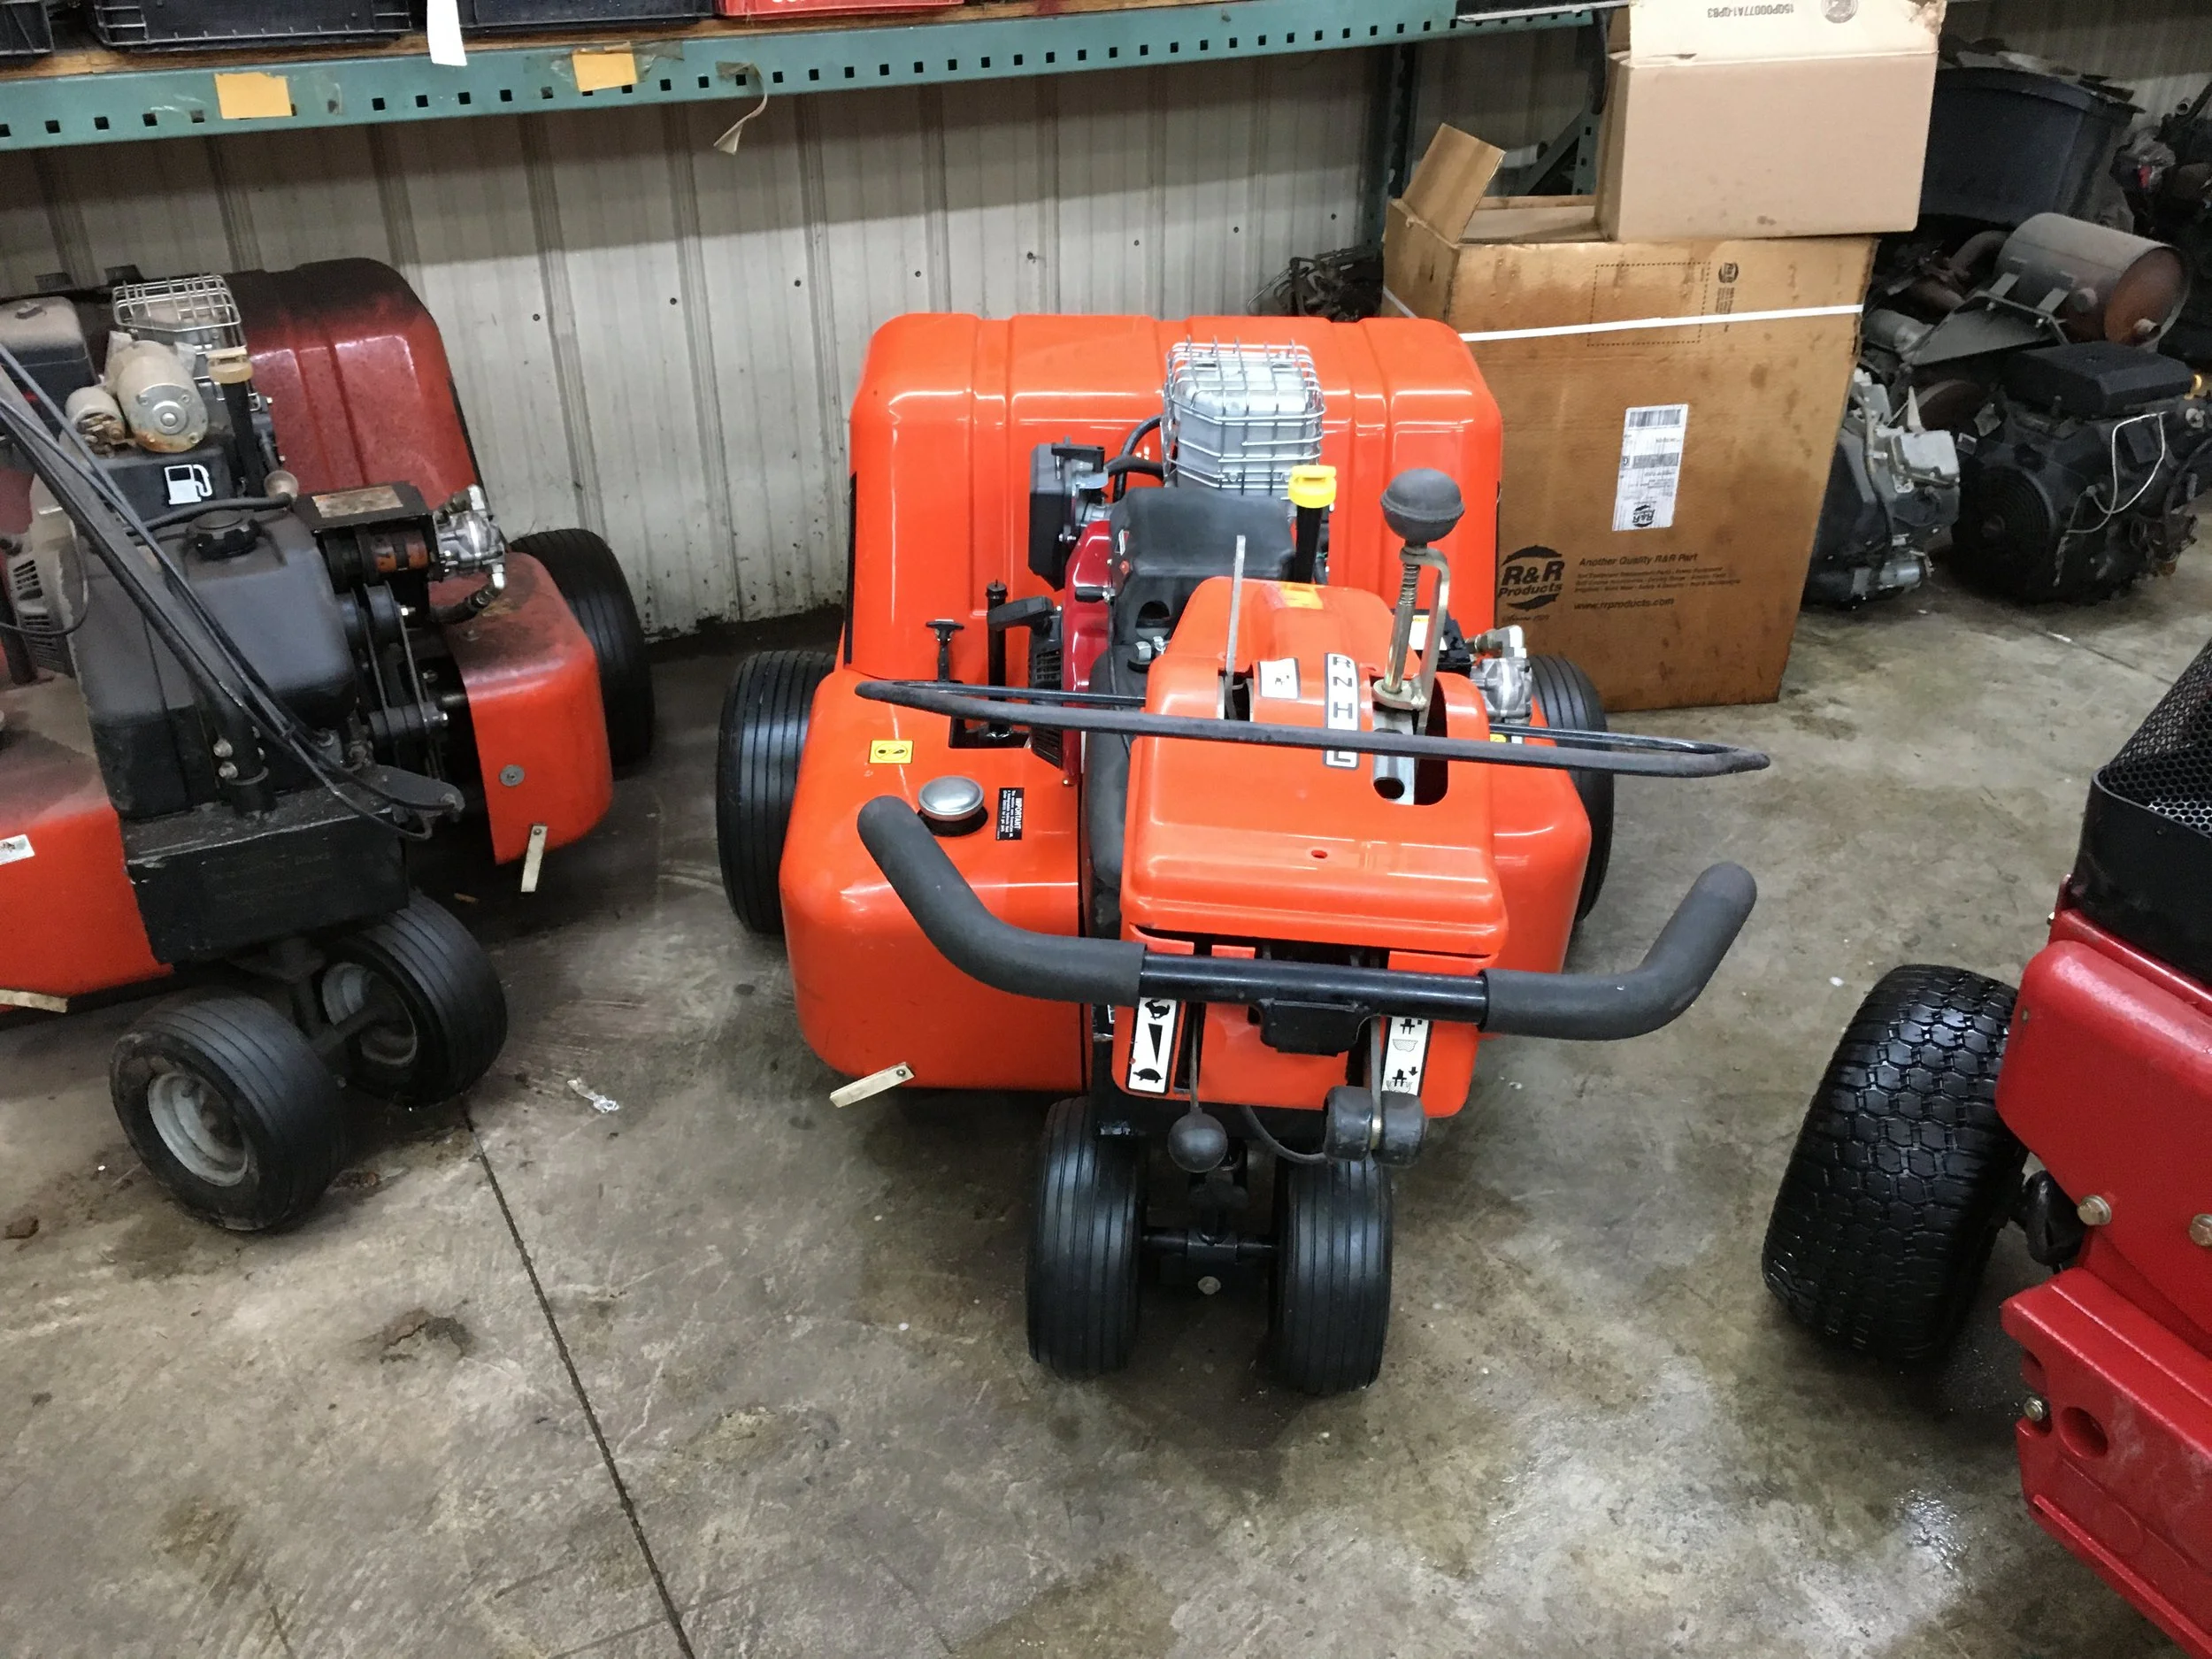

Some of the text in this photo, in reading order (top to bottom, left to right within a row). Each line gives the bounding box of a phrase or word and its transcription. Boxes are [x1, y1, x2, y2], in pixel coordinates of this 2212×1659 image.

[1579, 552, 1698, 566] Another Quality R&R Part
[1502, 560, 1565, 586] R&R
[1497, 582, 1563, 598] Products
[1573, 596, 1675, 611] www.rrproducts.com
[1333, 656, 1351, 668] R
[1333, 676, 1353, 687] N
[1333, 702, 1353, 719] H
